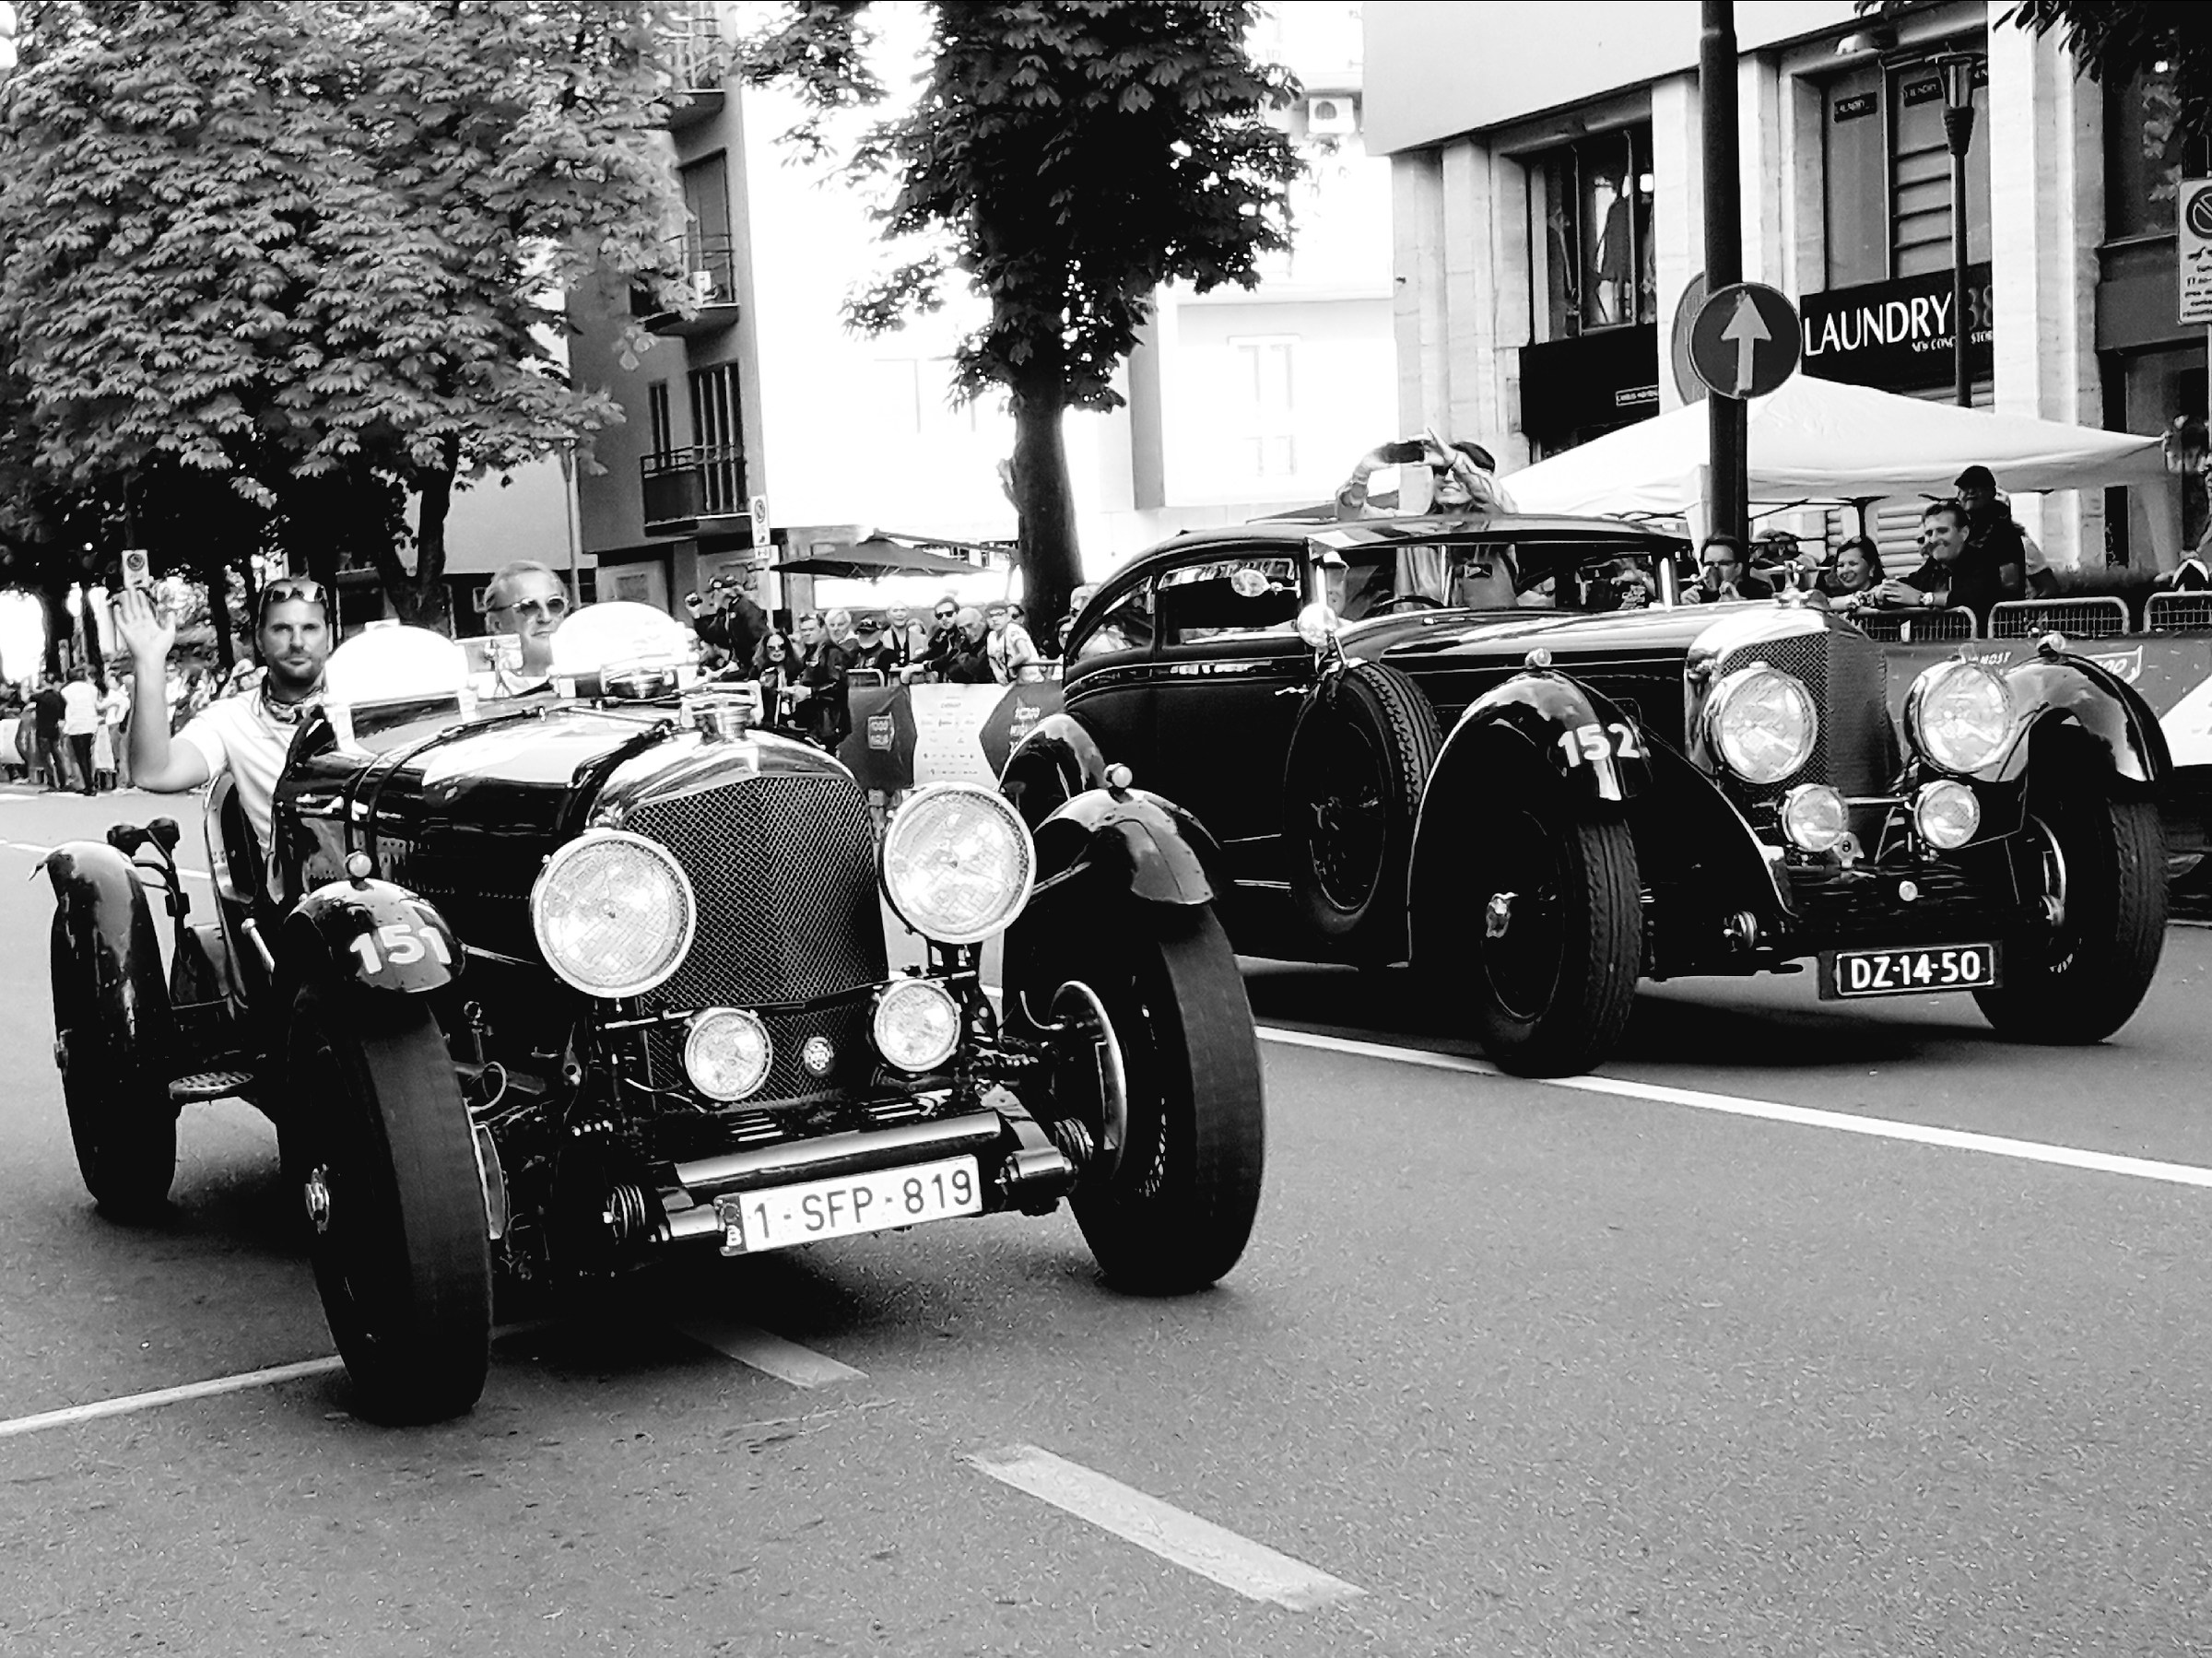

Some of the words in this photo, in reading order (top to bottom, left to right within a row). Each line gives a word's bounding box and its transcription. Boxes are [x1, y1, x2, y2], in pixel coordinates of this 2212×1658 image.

[1804, 291, 1953, 357] LAUNDRY
[1557, 723, 1641, 768] 152
[349, 923, 452, 974] 151
[1851, 950, 1981, 989] DZ-14-50
[726, 1224, 742, 1246] B
[754, 1169, 972, 1239] 1-SFP-819
